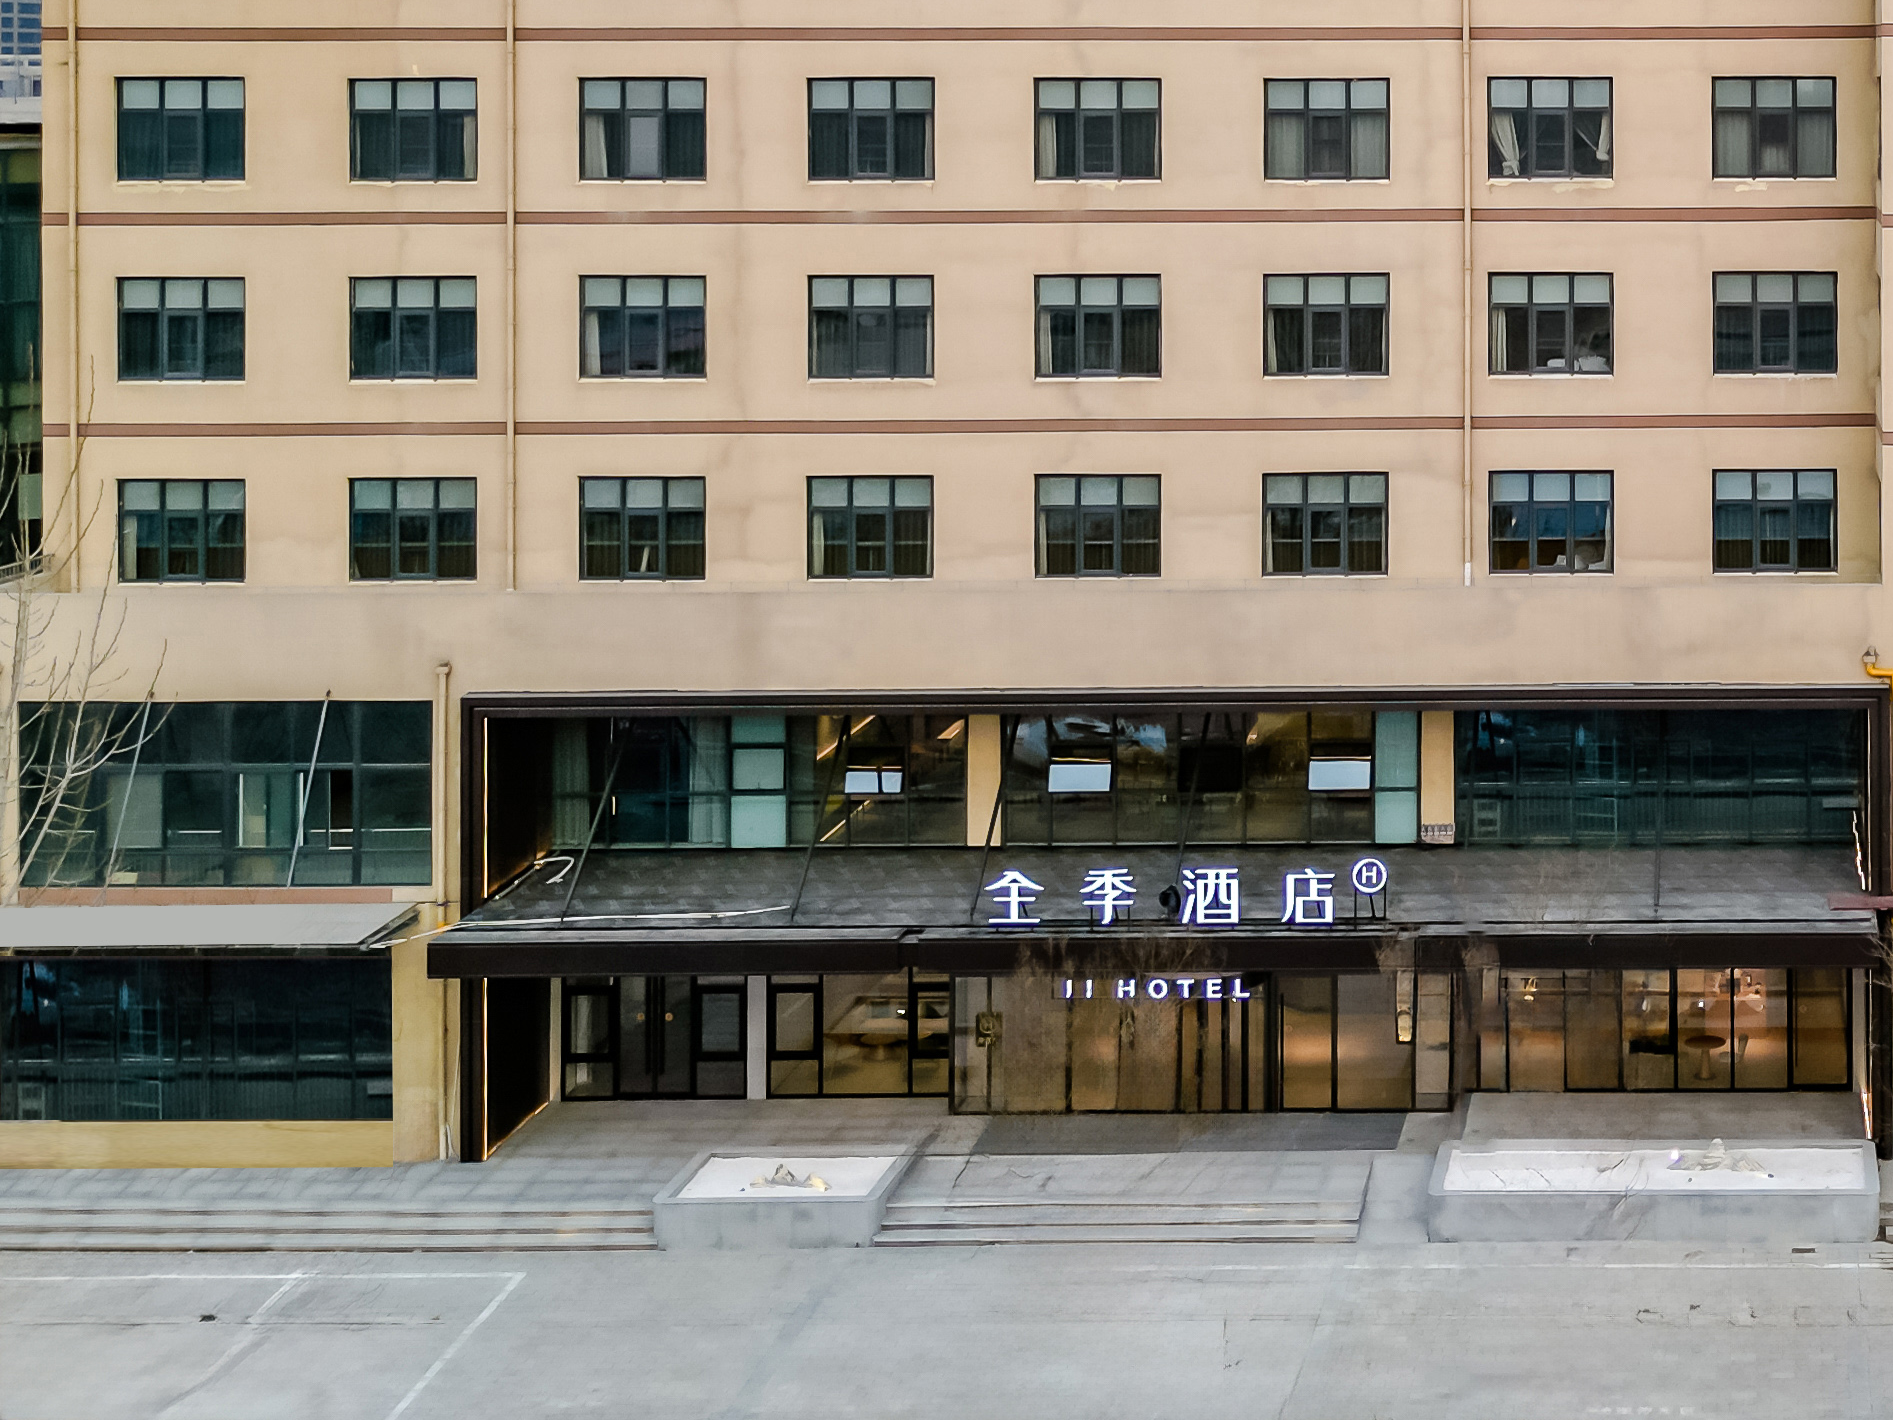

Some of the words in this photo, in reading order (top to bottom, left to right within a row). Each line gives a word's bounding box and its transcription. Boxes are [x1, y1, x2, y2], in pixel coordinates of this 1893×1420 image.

[984, 868, 1336, 925] 全季酒店
[1064, 979, 1094, 999] JI
[1116, 979, 1251, 1000] HOTEL
